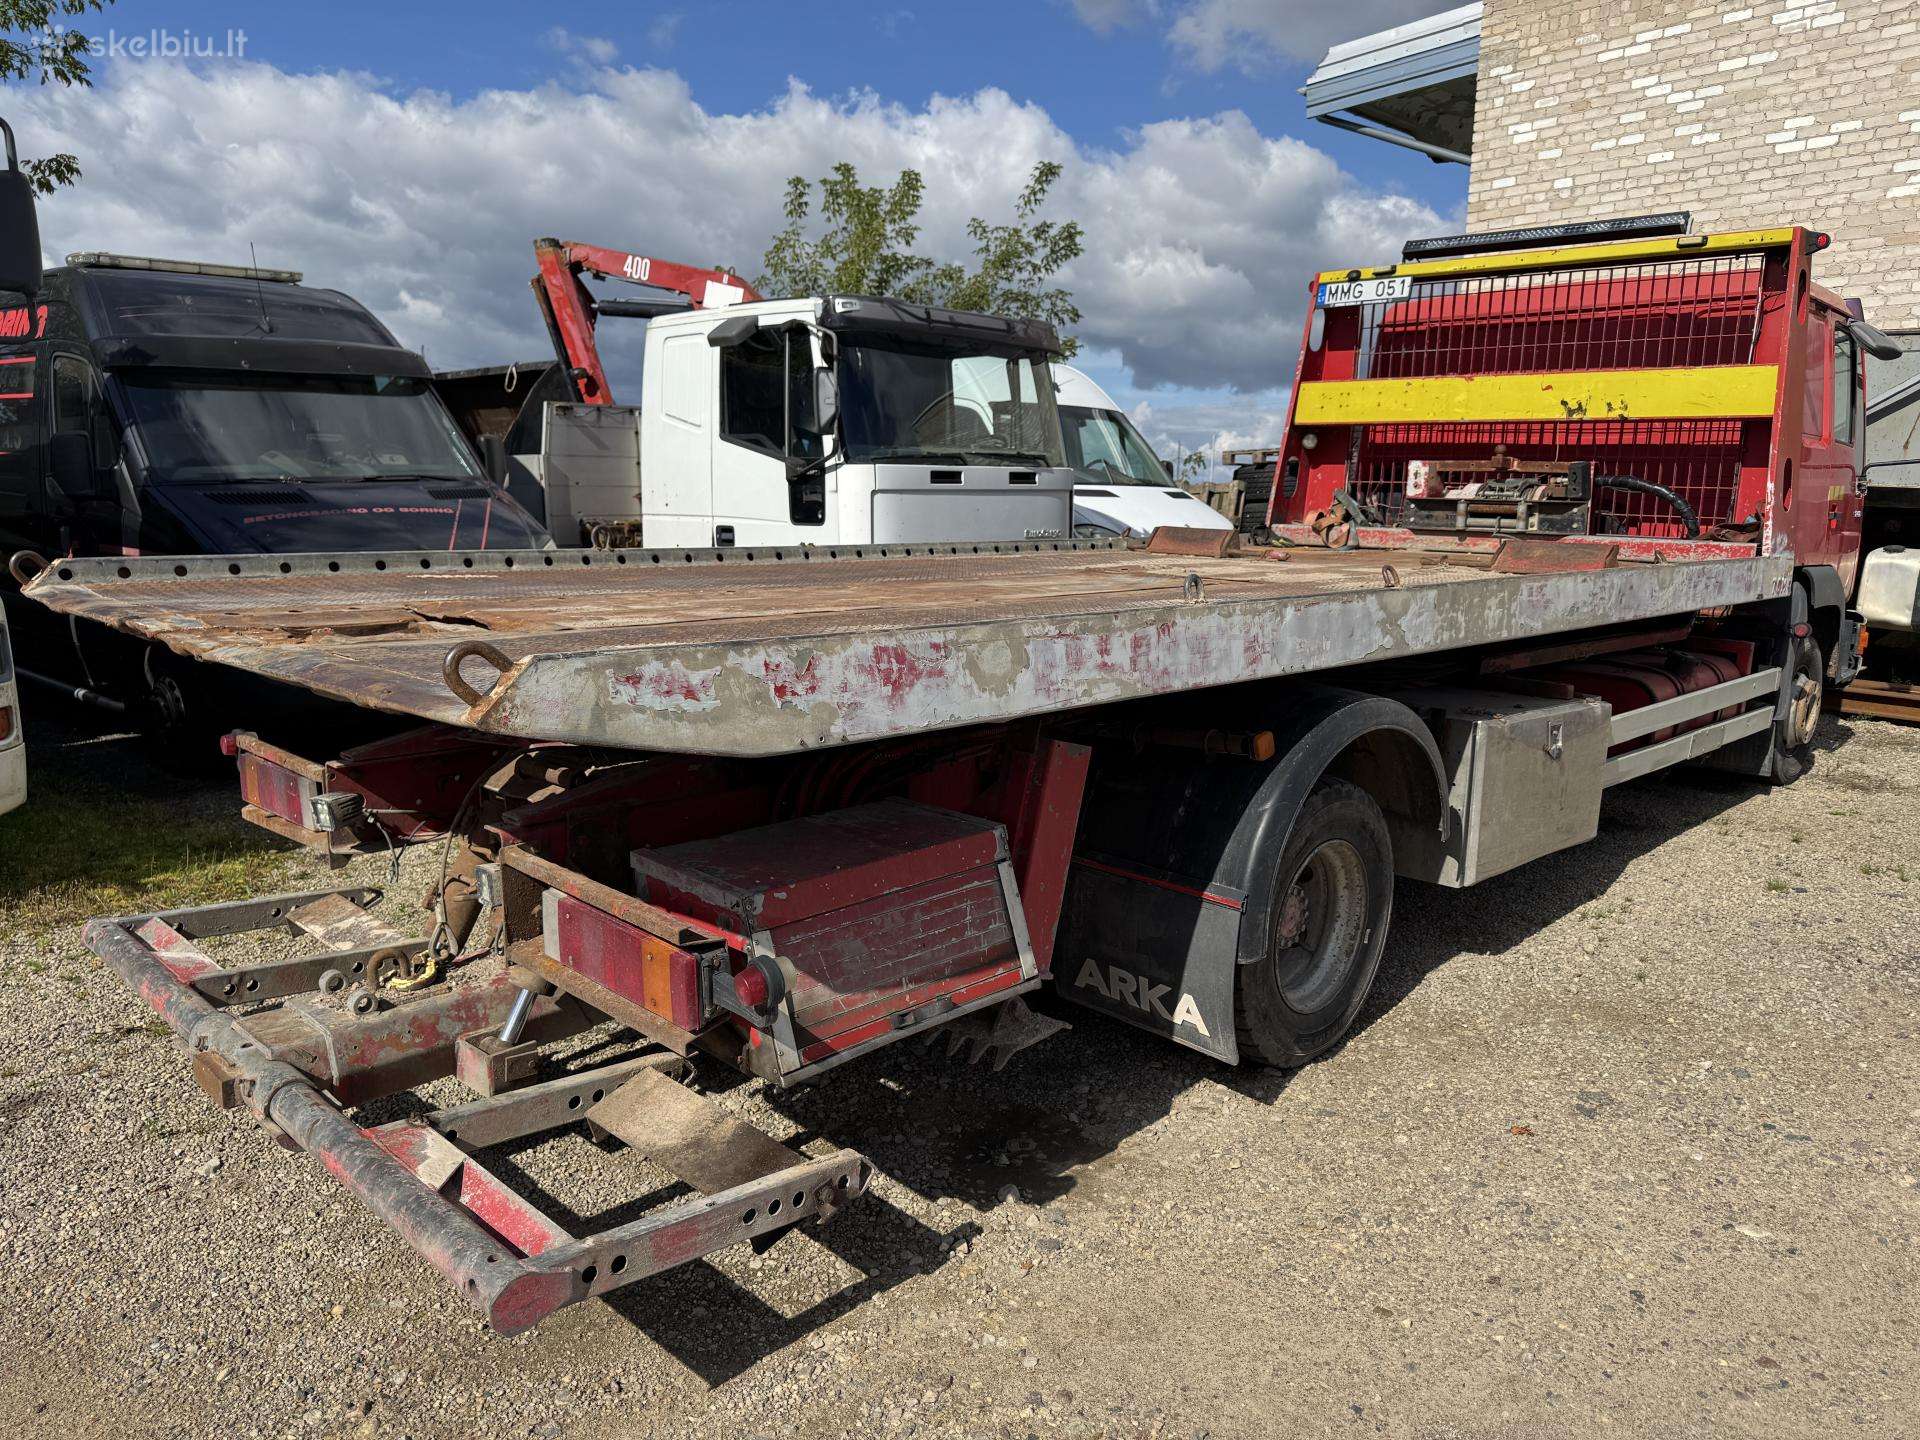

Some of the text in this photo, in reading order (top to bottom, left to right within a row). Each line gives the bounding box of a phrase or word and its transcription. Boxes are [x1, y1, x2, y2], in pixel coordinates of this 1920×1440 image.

[623, 254, 650, 281] 400
[1327, 279, 1406, 302] MMG 051
[1075, 958, 1210, 1038] ARKA
